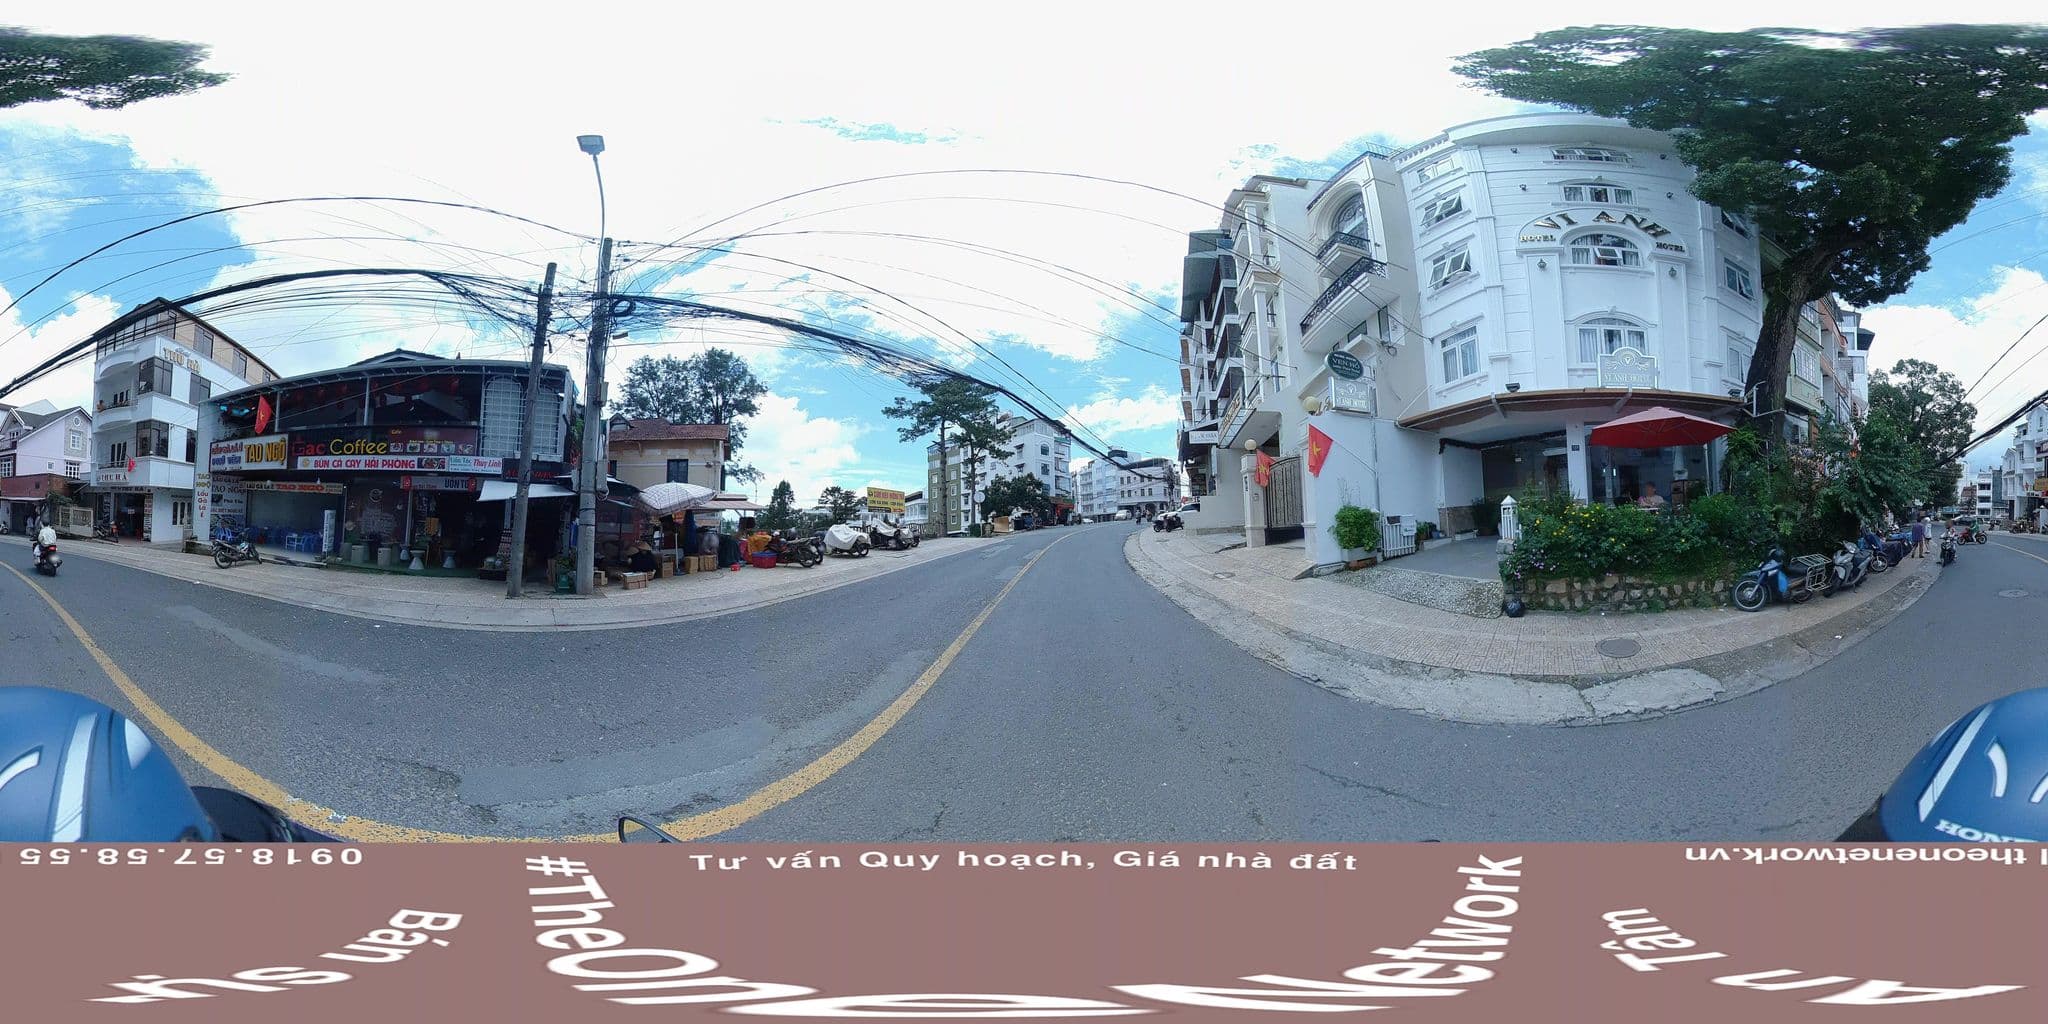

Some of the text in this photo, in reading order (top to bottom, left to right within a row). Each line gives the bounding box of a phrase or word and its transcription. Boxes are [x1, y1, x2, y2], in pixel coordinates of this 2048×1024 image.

[1534, 210, 1671, 238] VI ANH
[1520, 234, 1557, 243] HOTEL
[1656, 241, 1686, 253] HOTEL
[244, 437, 287, 466] TAO NGỘ
[329, 438, 388, 455] Coffee
